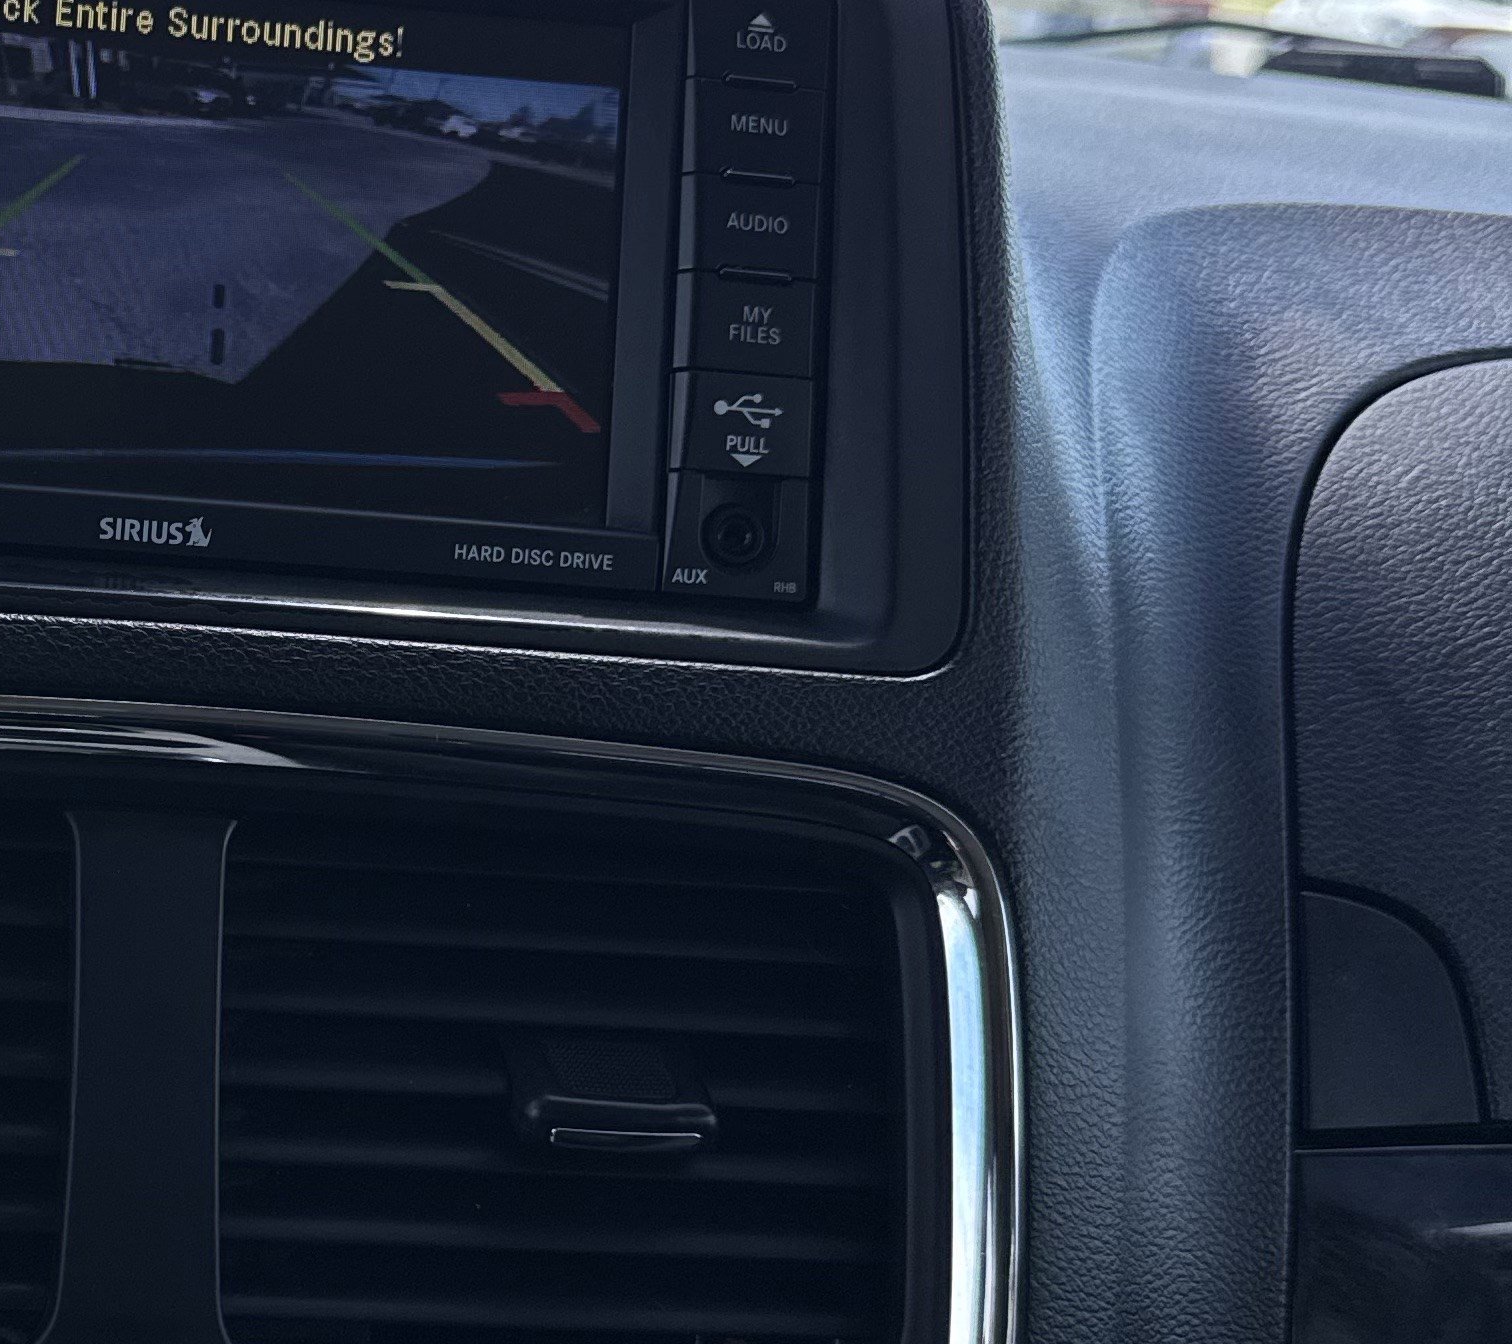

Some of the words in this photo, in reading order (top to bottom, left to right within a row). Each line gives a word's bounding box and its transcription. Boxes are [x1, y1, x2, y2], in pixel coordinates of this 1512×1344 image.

[168, 6, 404, 64] Surroundings!
[736, 29, 787, 53] LOAD
[730, 114, 788, 137] MENU
[726, 212, 789, 235] AUDIO
[743, 305, 773, 324] MY
[728, 323, 781, 345] FILES
[725, 434, 771, 455] PULL
[99, 516, 184, 545] SIRIUS
[454, 543, 507, 563] HARD
[510, 547, 554, 567] DISC
[559, 551, 614, 571] DRIVE
[671, 567, 708, 584] AUX
